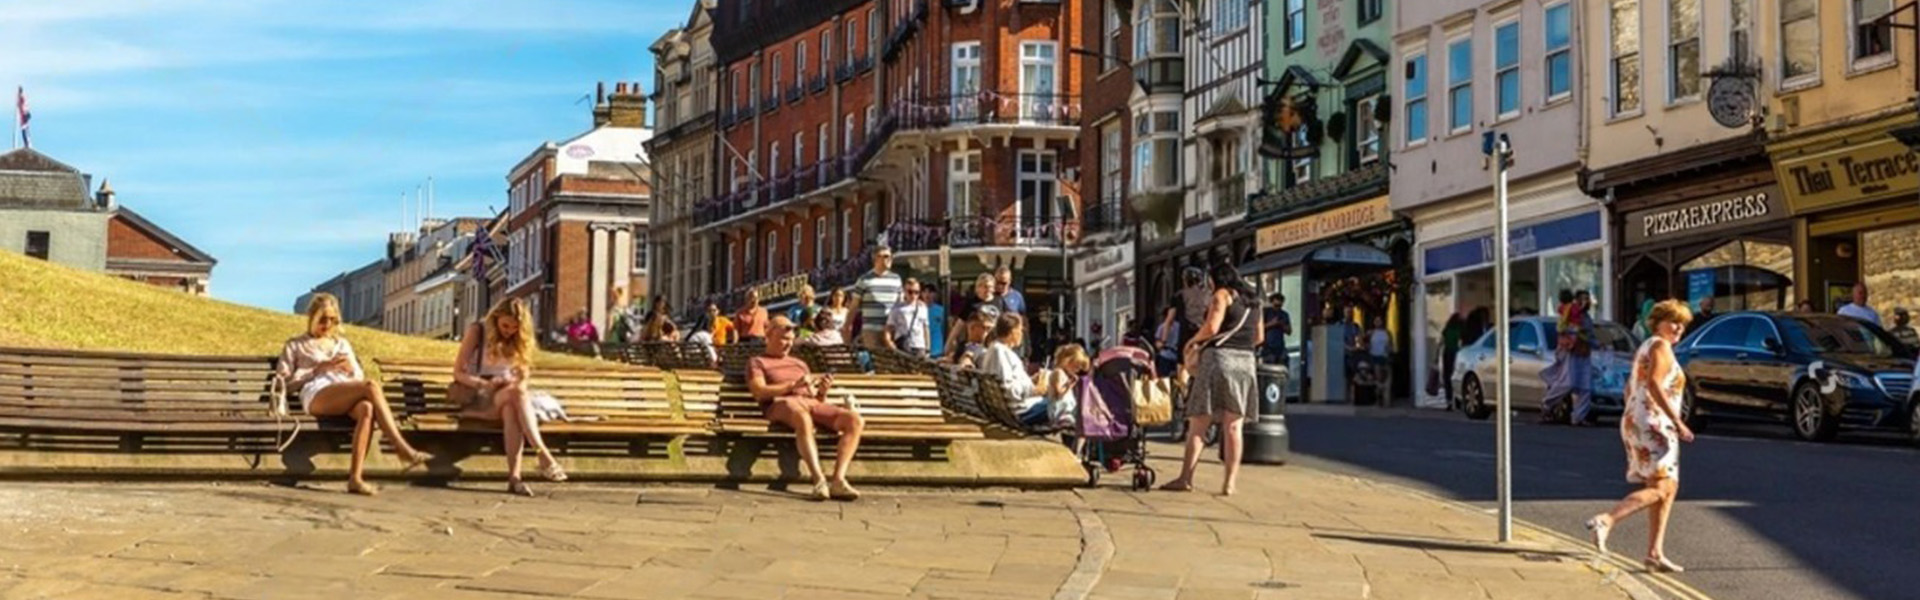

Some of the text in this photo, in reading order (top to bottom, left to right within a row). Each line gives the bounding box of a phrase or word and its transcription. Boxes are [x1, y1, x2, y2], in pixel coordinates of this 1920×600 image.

[1789, 153, 1919, 195] Thai Terrace
[1271, 220, 1310, 246] DUCHESS
[1321, 205, 1376, 234] CAMBRIDGE
[1643, 193, 1768, 237] PIZZAEXPRESS
